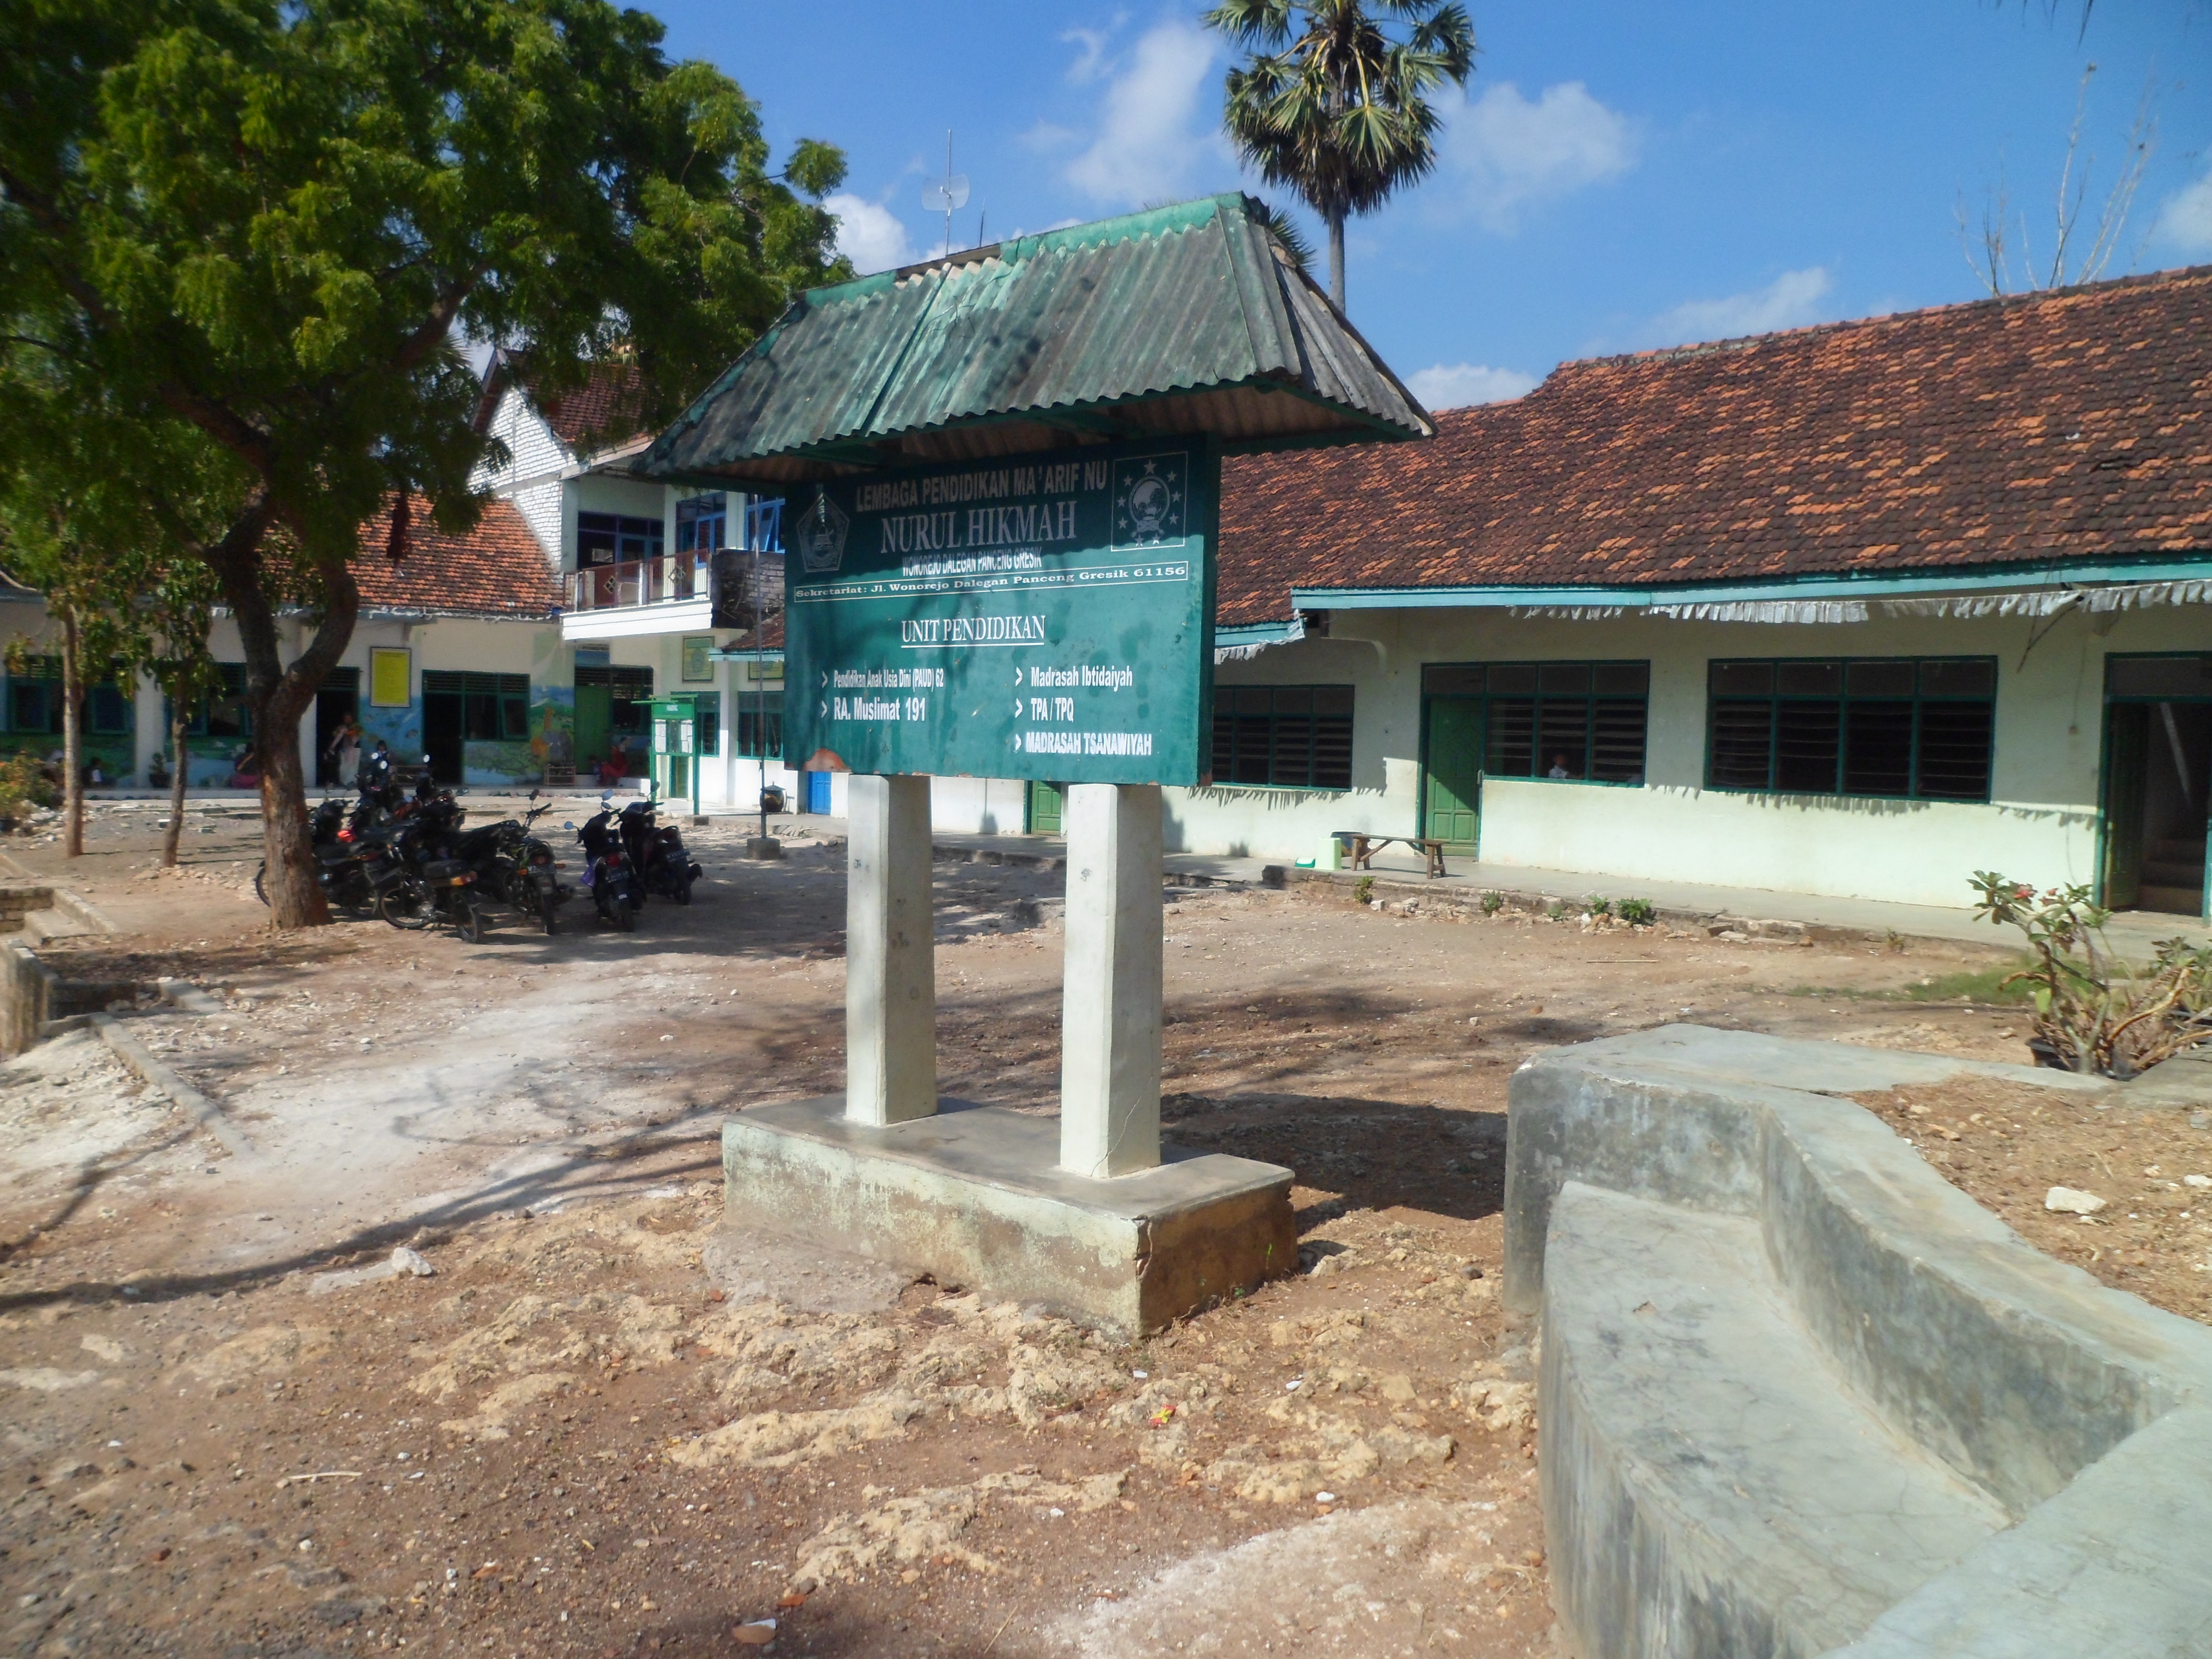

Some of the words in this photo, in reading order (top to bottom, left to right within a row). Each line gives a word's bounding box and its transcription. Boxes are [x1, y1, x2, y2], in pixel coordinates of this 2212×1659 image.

[857, 479, 918, 513] LEMBAGA
[923, 469, 1009, 505] PENDIDIKAN
[1014, 463, 1079, 496] MA'ARIF
[1084, 460, 1108, 491] NU
[881, 512, 961, 554] NURUL
[967, 501, 1077, 546] HIKMAH
[903, 555, 941, 577] WONOREJO
[943, 552, 976, 574] DALEGAN
[979, 549, 1012, 571] PANCENG
[1014, 546, 1042, 569] GRESIK
[796, 587, 867, 597] Sekretariat:
[889, 582, 949, 591] Wonorejo
[954, 579, 1008, 588] Dalegan
[1013, 575, 1075, 584] Panceng
[1079, 569, 1129, 580] Gresik
[1134, 567, 1185, 577] 61156
[901, 619, 940, 642] UNIT
[943, 615, 1046, 641] PENDIDIKAN
[834, 670, 866, 688] Pendidikan
[867, 669, 883, 688] Anak
[884, 669, 898, 687] Usia
[899, 669, 911, 688] Dini
[912, 668, 934, 692] (PAUD)
[935, 668, 944, 688] 62
[1031, 666, 1079, 687] Madrasah
[1082, 665, 1133, 692] Ibtidaiyah
[834, 697, 851, 720] RA.
[854, 696, 900, 720] Muslimat
[906, 697, 926, 721] 191
[1031, 698, 1048, 721] TPA
[1055, 697, 1074, 722] TPQ
[1026, 732, 1081, 754] MADRASAH
[1083, 733, 1152, 755] TSANAWIYAH
